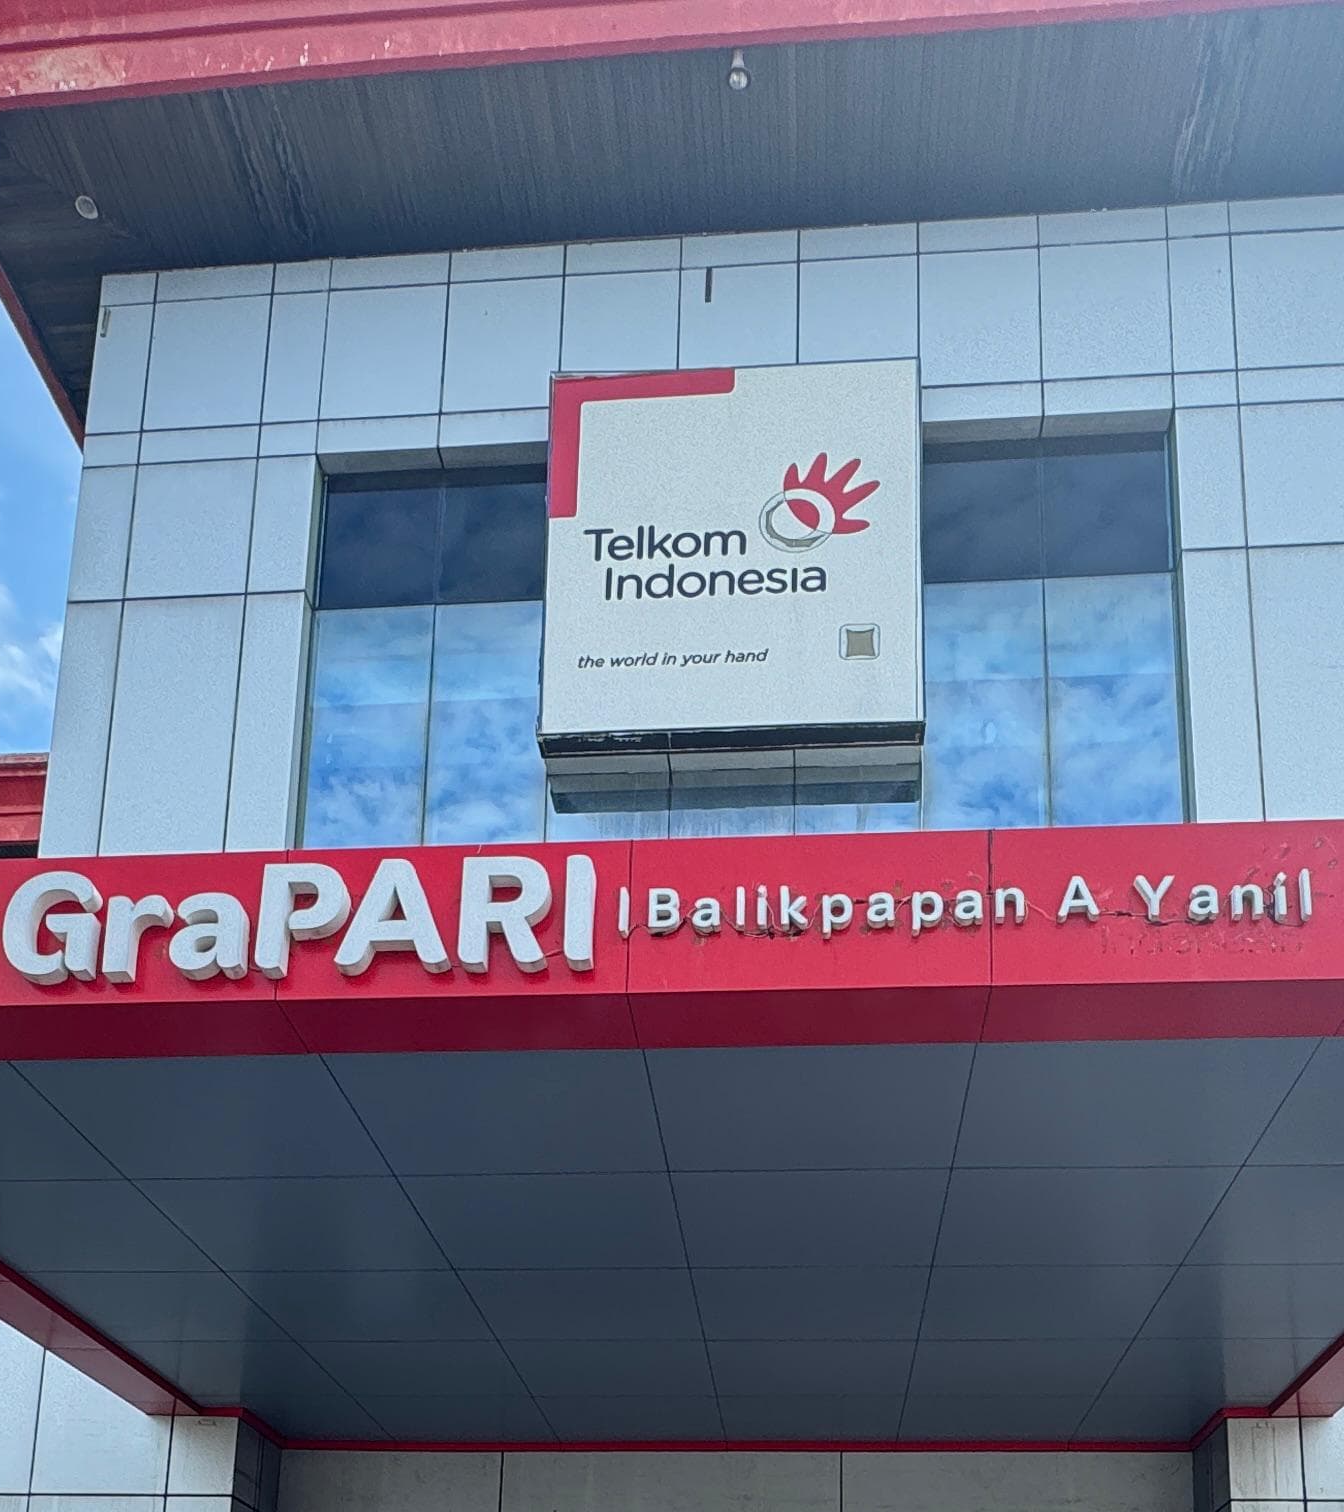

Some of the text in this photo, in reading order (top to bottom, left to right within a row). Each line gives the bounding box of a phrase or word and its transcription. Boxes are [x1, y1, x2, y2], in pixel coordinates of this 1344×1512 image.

[584, 525, 746, 561] Telkom
[605, 563, 827, 600] Indonesia
[577, 648, 769, 669] the world in your hand
[2, 854, 598, 985] GraPARI
[647, 884, 1027, 939] Balikpapan
